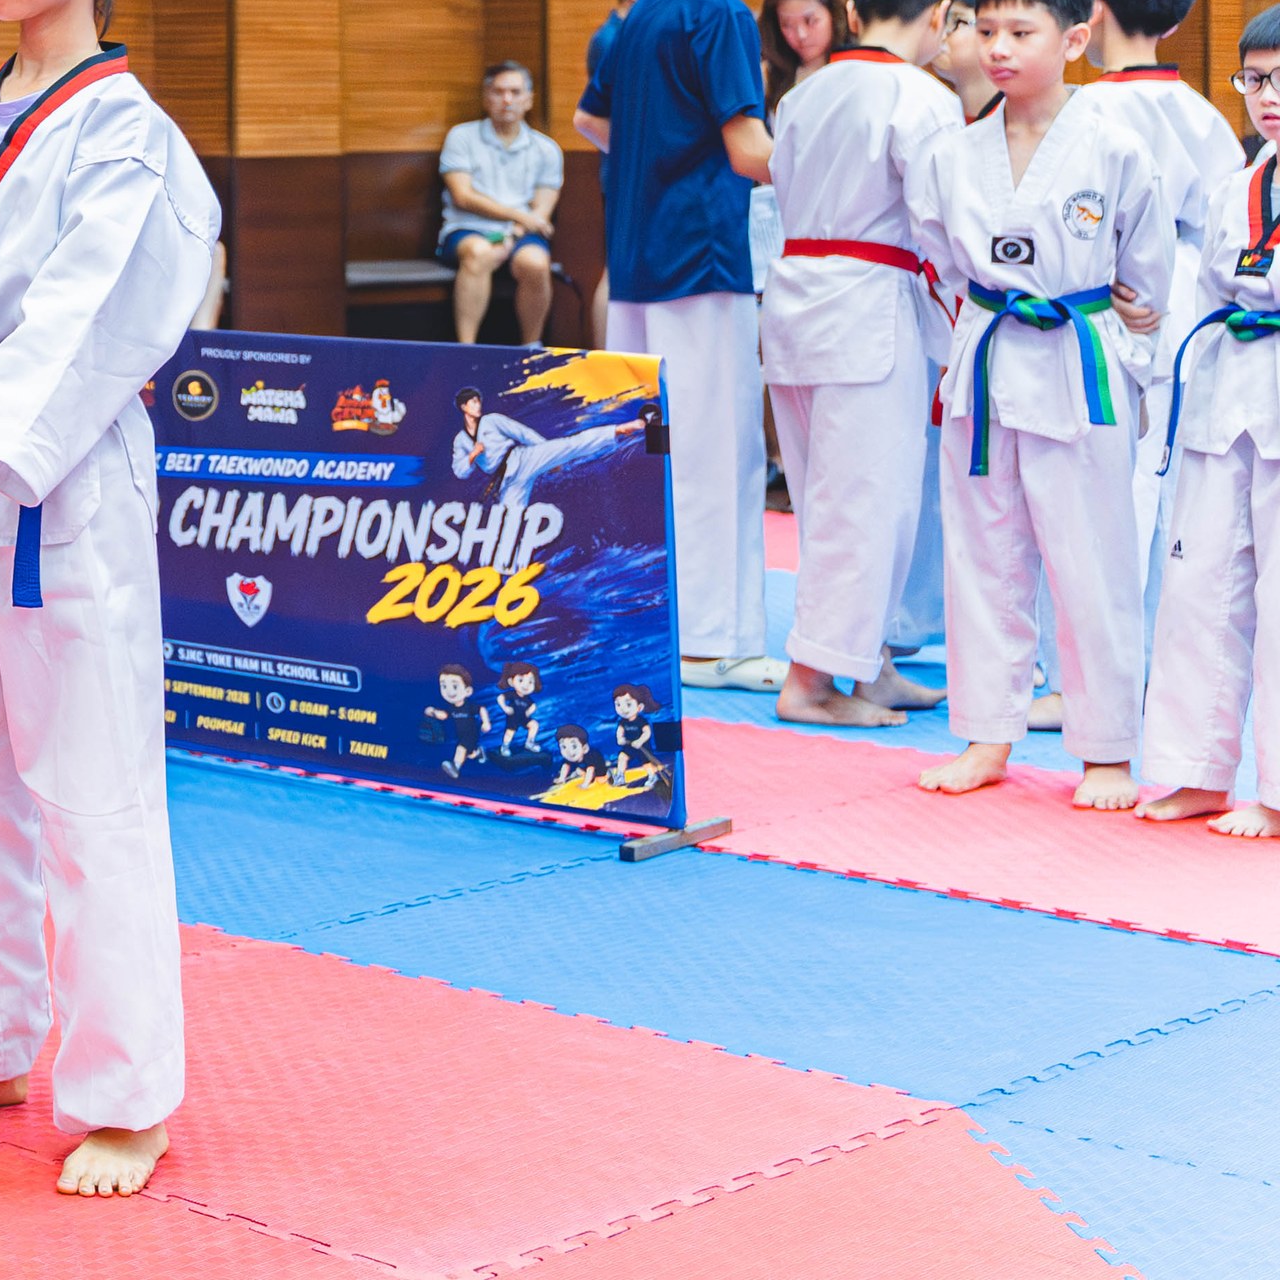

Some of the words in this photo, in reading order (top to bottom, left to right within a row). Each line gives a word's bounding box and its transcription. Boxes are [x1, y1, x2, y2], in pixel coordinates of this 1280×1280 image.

[165, 452, 206, 472] BELT
[208, 454, 308, 478] TAEKWONDO
[311, 459, 396, 482] ACADEMY
[168, 485, 564, 575] CHAMPIONSHIP
[366, 562, 546, 628] 2026
[276, 663, 320, 682] SCHOOL
[321, 669, 351, 686] HALL
